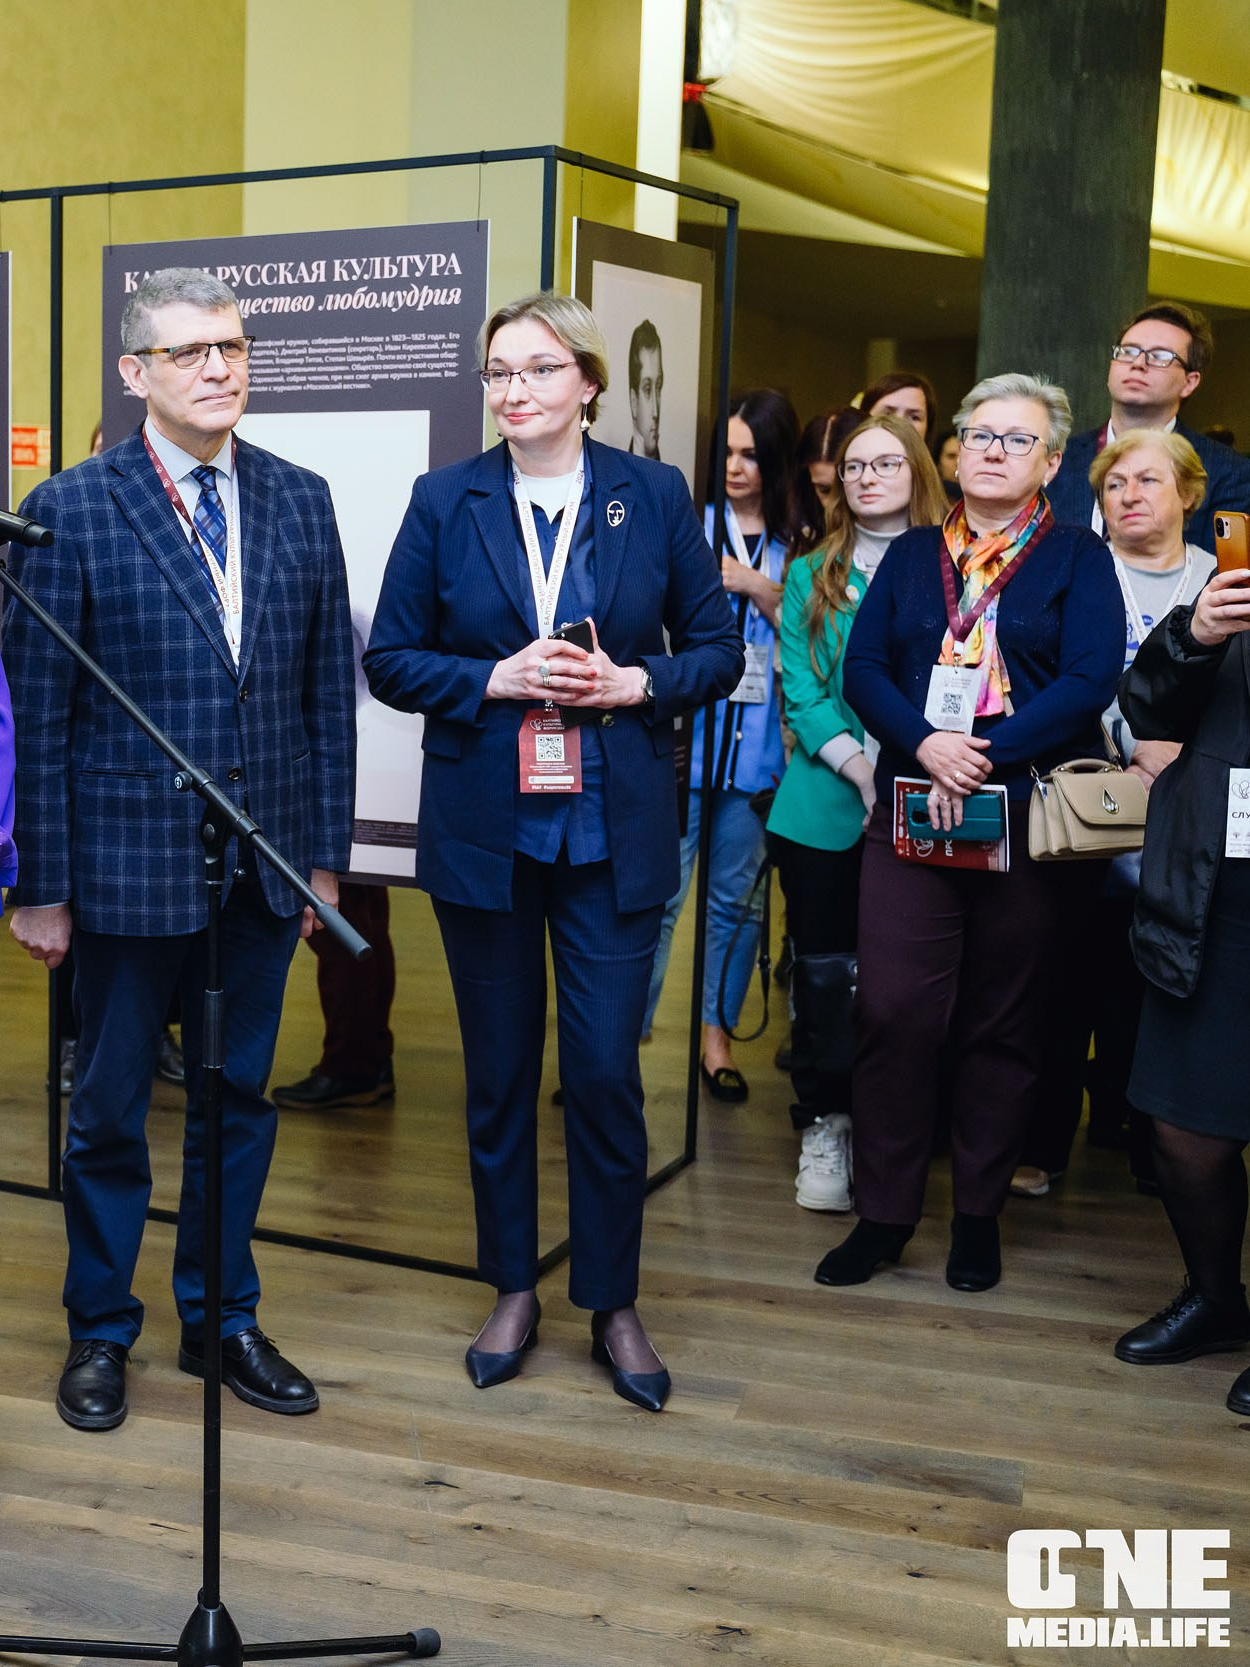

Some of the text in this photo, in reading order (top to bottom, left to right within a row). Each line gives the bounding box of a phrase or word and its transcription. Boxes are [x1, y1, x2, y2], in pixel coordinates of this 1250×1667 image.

[216, 252, 464, 289] РУССКАЯ КУЛЬТУРА
[238, 283, 463, 319] щество любомудрия
[576, 469, 585, 484] 2024
[232, 560, 240, 614] БАЛТИЙСКИЙ
